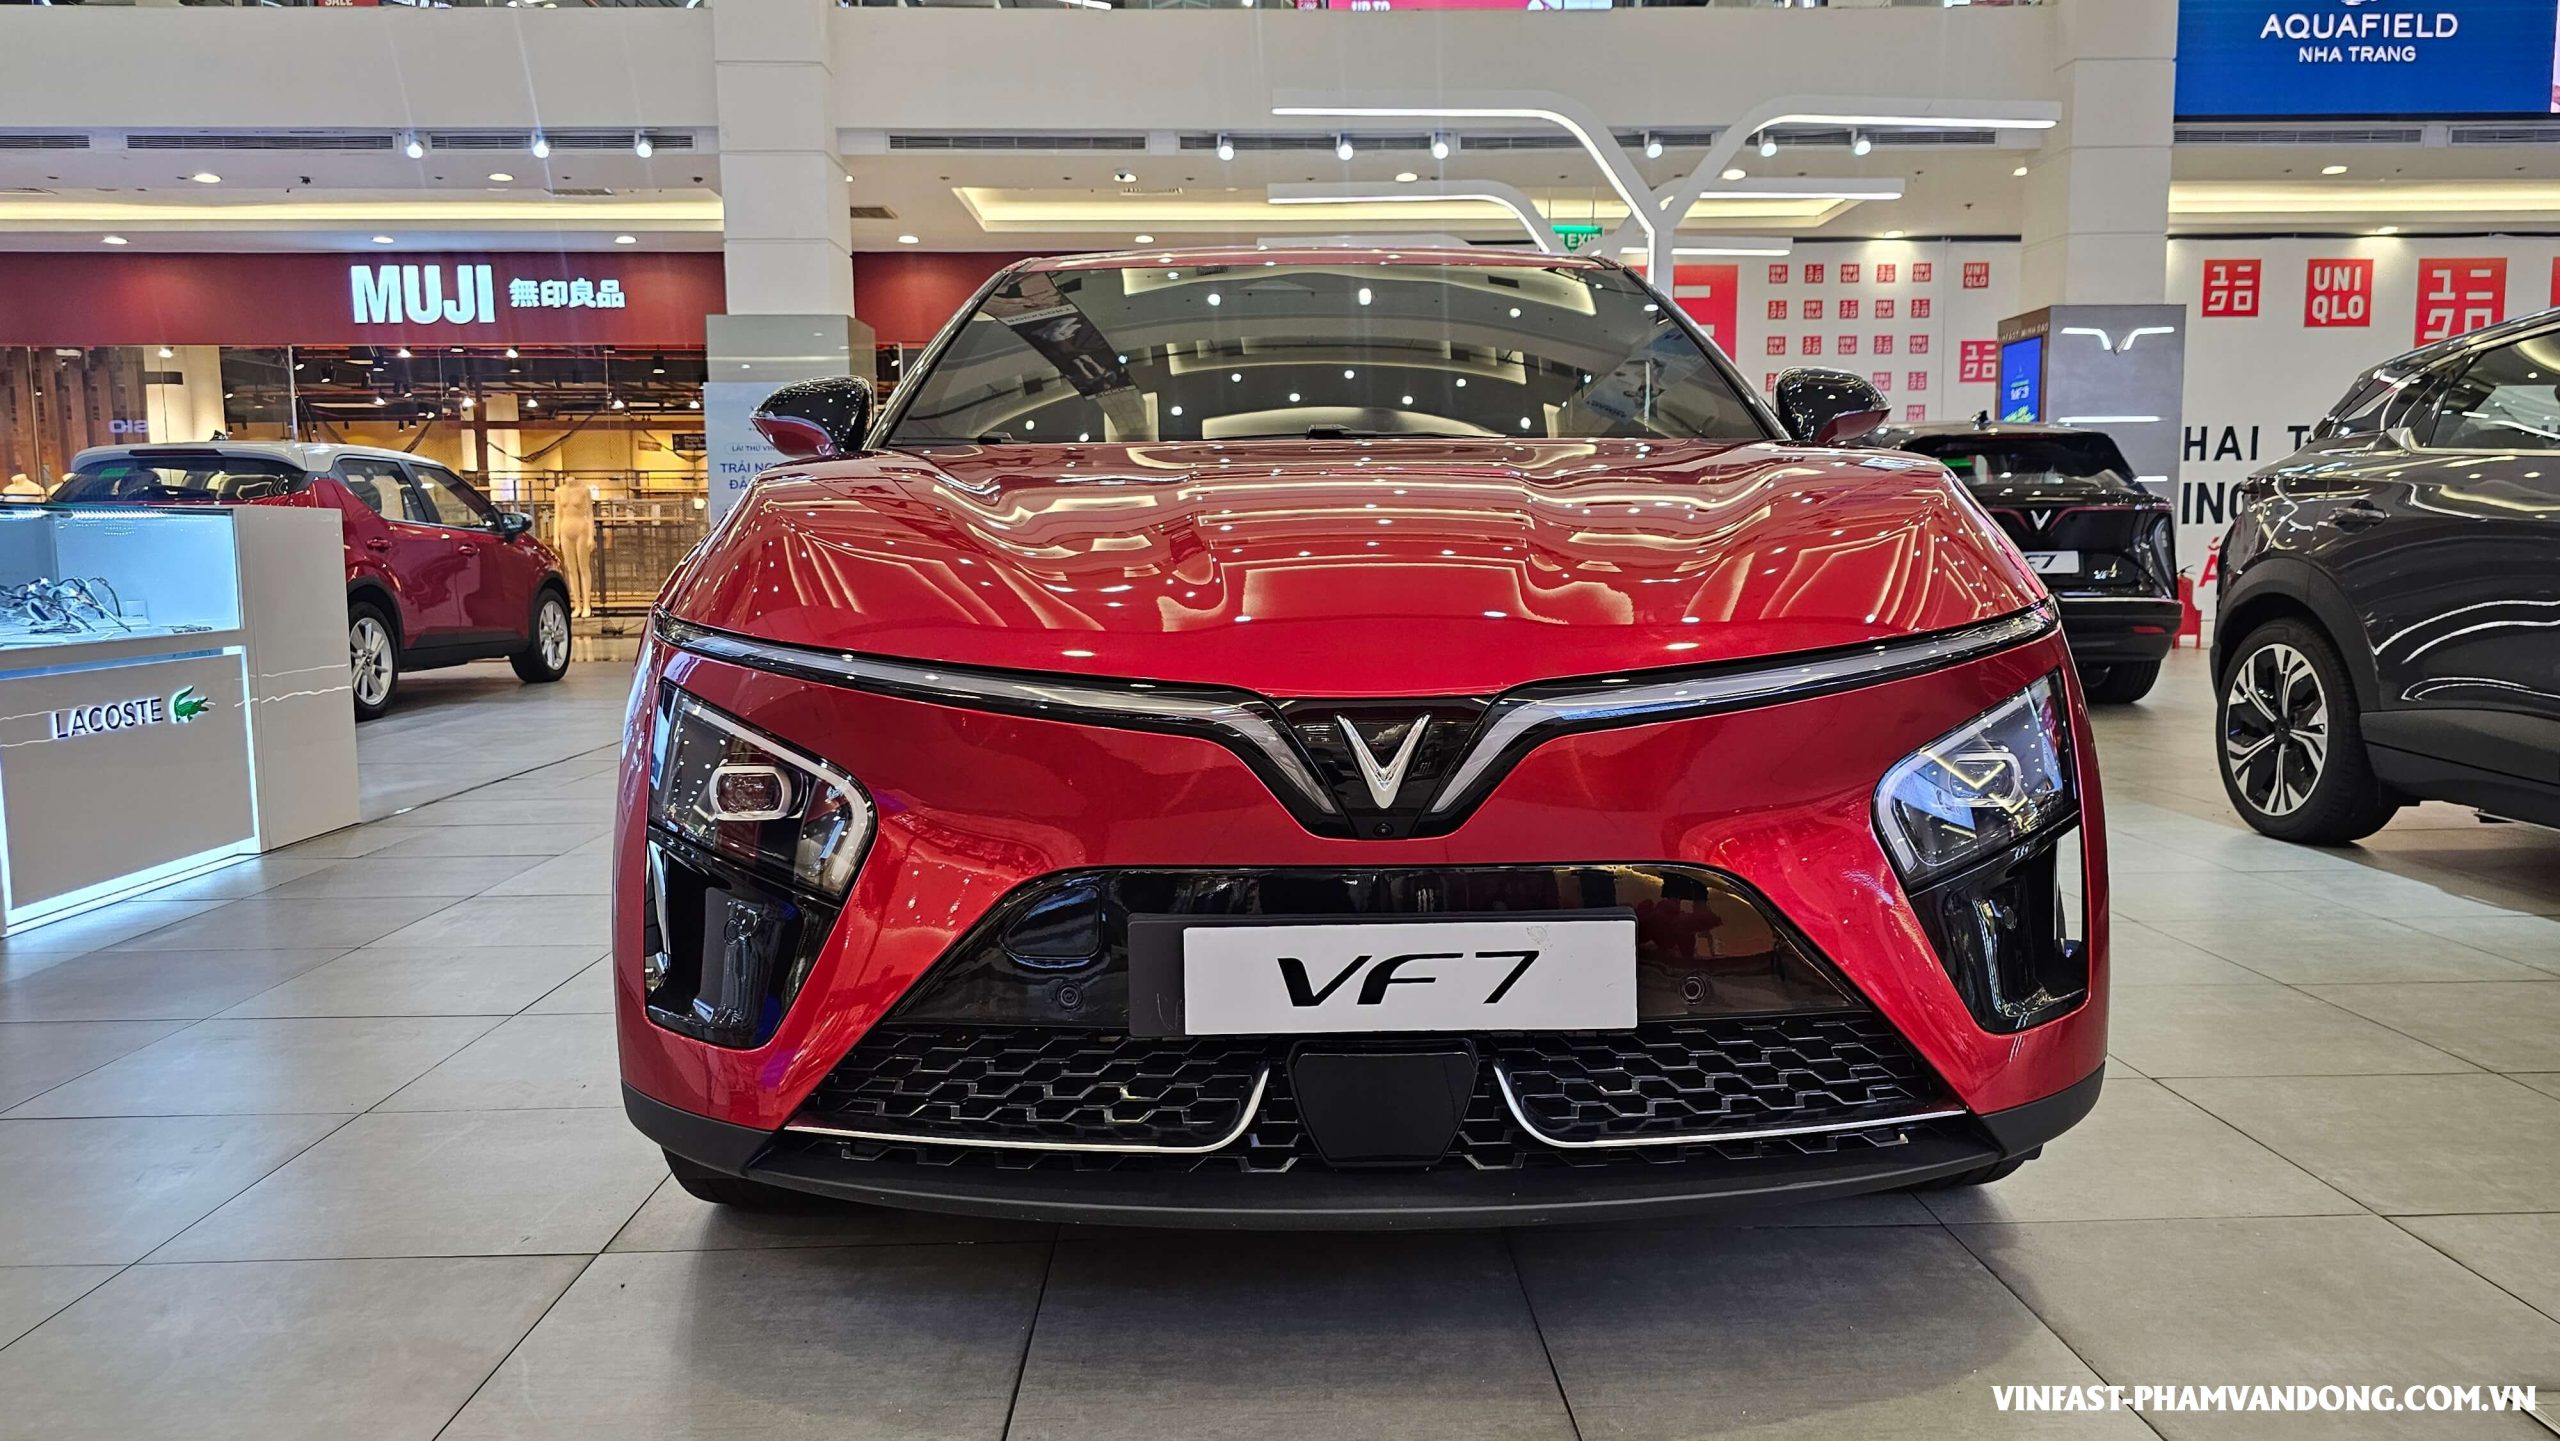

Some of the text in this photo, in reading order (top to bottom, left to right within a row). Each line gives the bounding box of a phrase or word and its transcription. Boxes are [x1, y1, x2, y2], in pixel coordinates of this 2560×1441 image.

[2260, 13, 2459, 39] AQUAFIELD
[2299, 45, 2416, 62] NHA TRANG
[1965, 264, 1987, 275] UNI
[1965, 276, 1986, 287] QLO
[2314, 266, 2362, 291] UNI
[351, 265, 496, 324] MUJI
[509, 278, 626, 308] 無印良品
[2312, 296, 2364, 323] QLO
[52, 697, 164, 740] LACOSTE
